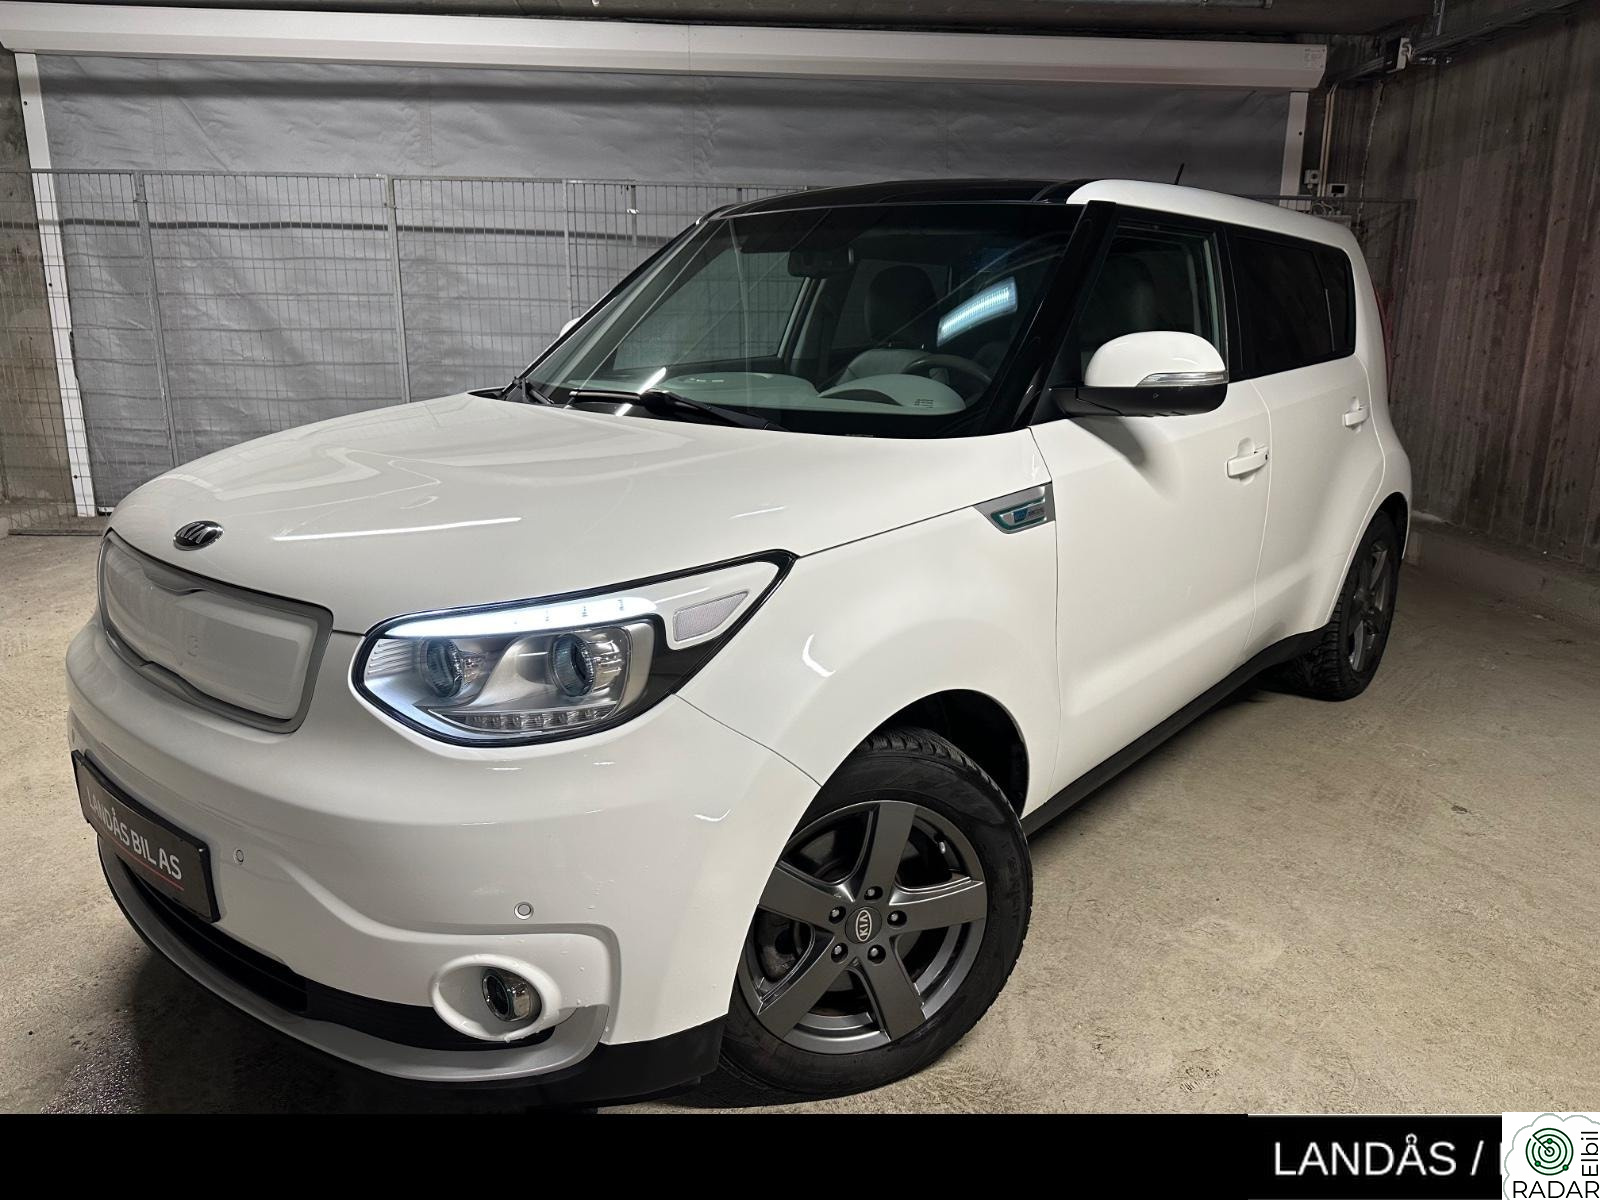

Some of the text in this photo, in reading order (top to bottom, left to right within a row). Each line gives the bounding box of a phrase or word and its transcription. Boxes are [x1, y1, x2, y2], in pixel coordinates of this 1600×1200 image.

[176, 522, 210, 544] KIA
[86, 785, 182, 880] LANDÅS BIL AS
[858, 913, 869, 937] KIA
